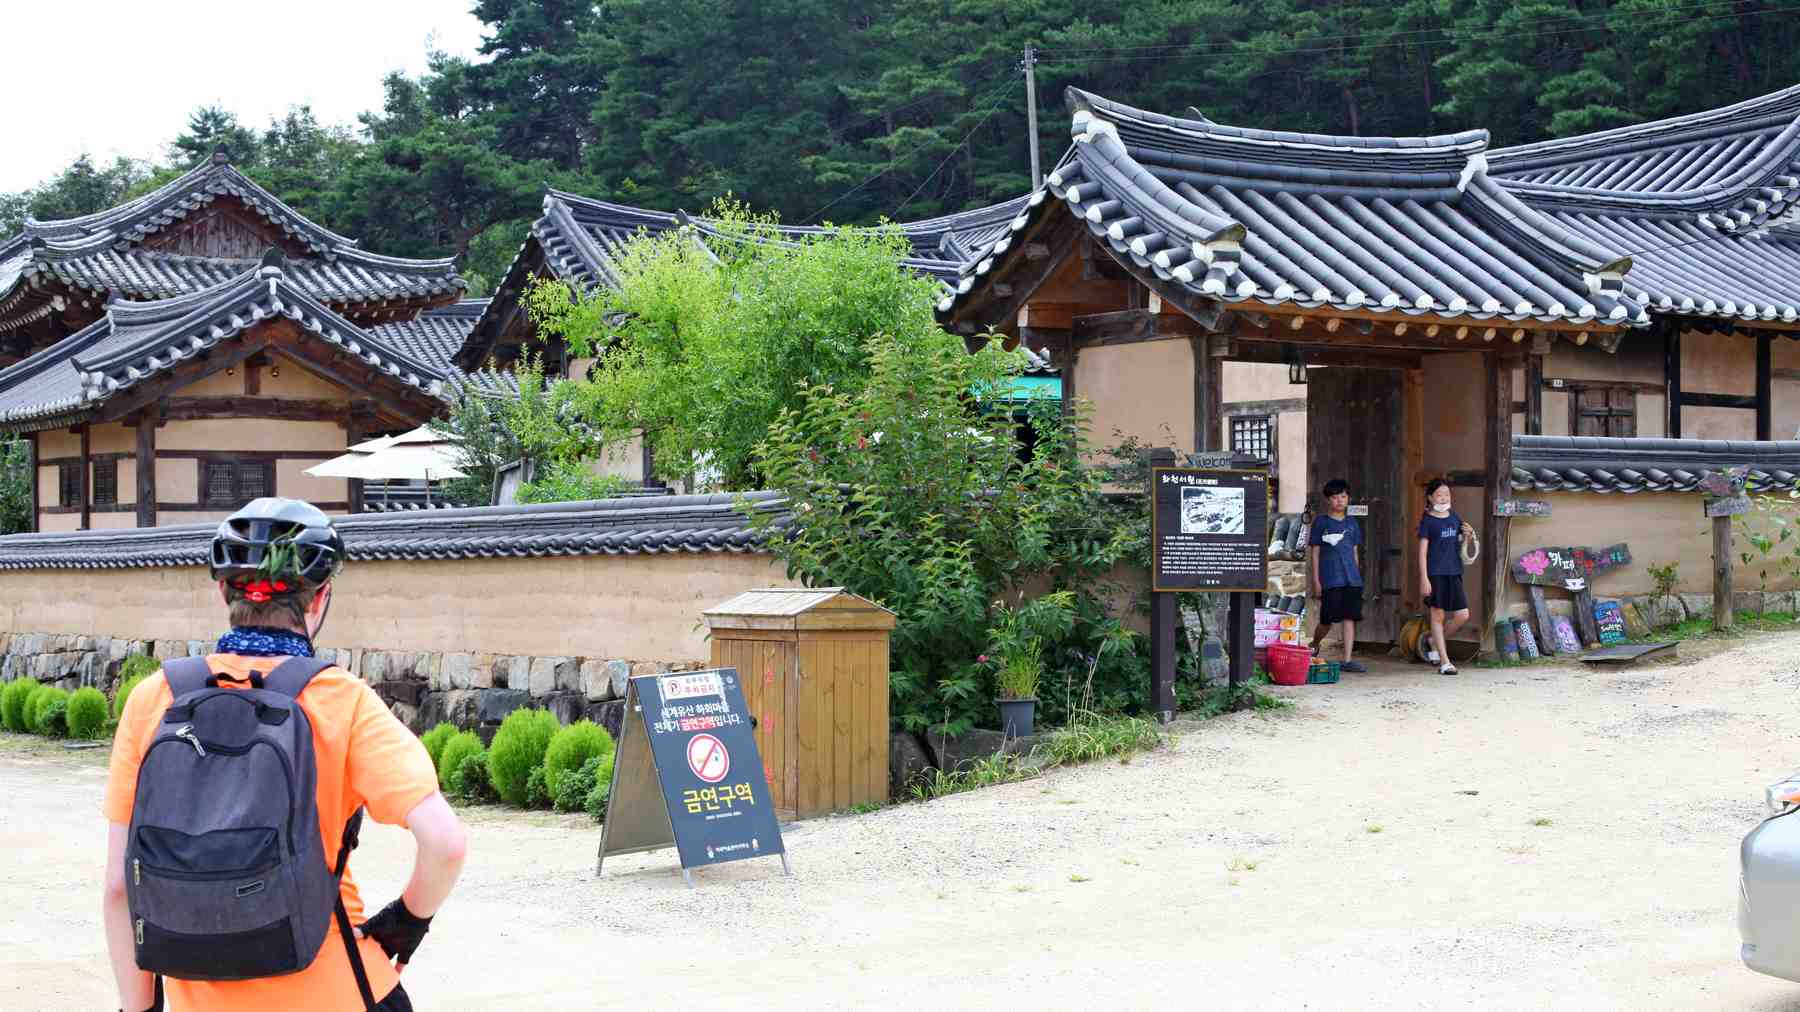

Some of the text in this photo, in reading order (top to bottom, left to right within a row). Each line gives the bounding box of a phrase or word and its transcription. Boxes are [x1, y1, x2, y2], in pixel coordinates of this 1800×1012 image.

[1548, 551, 1575, 569] 카페
[654, 719, 680, 733] 전체가
[683, 782, 755, 814] 금연구역
